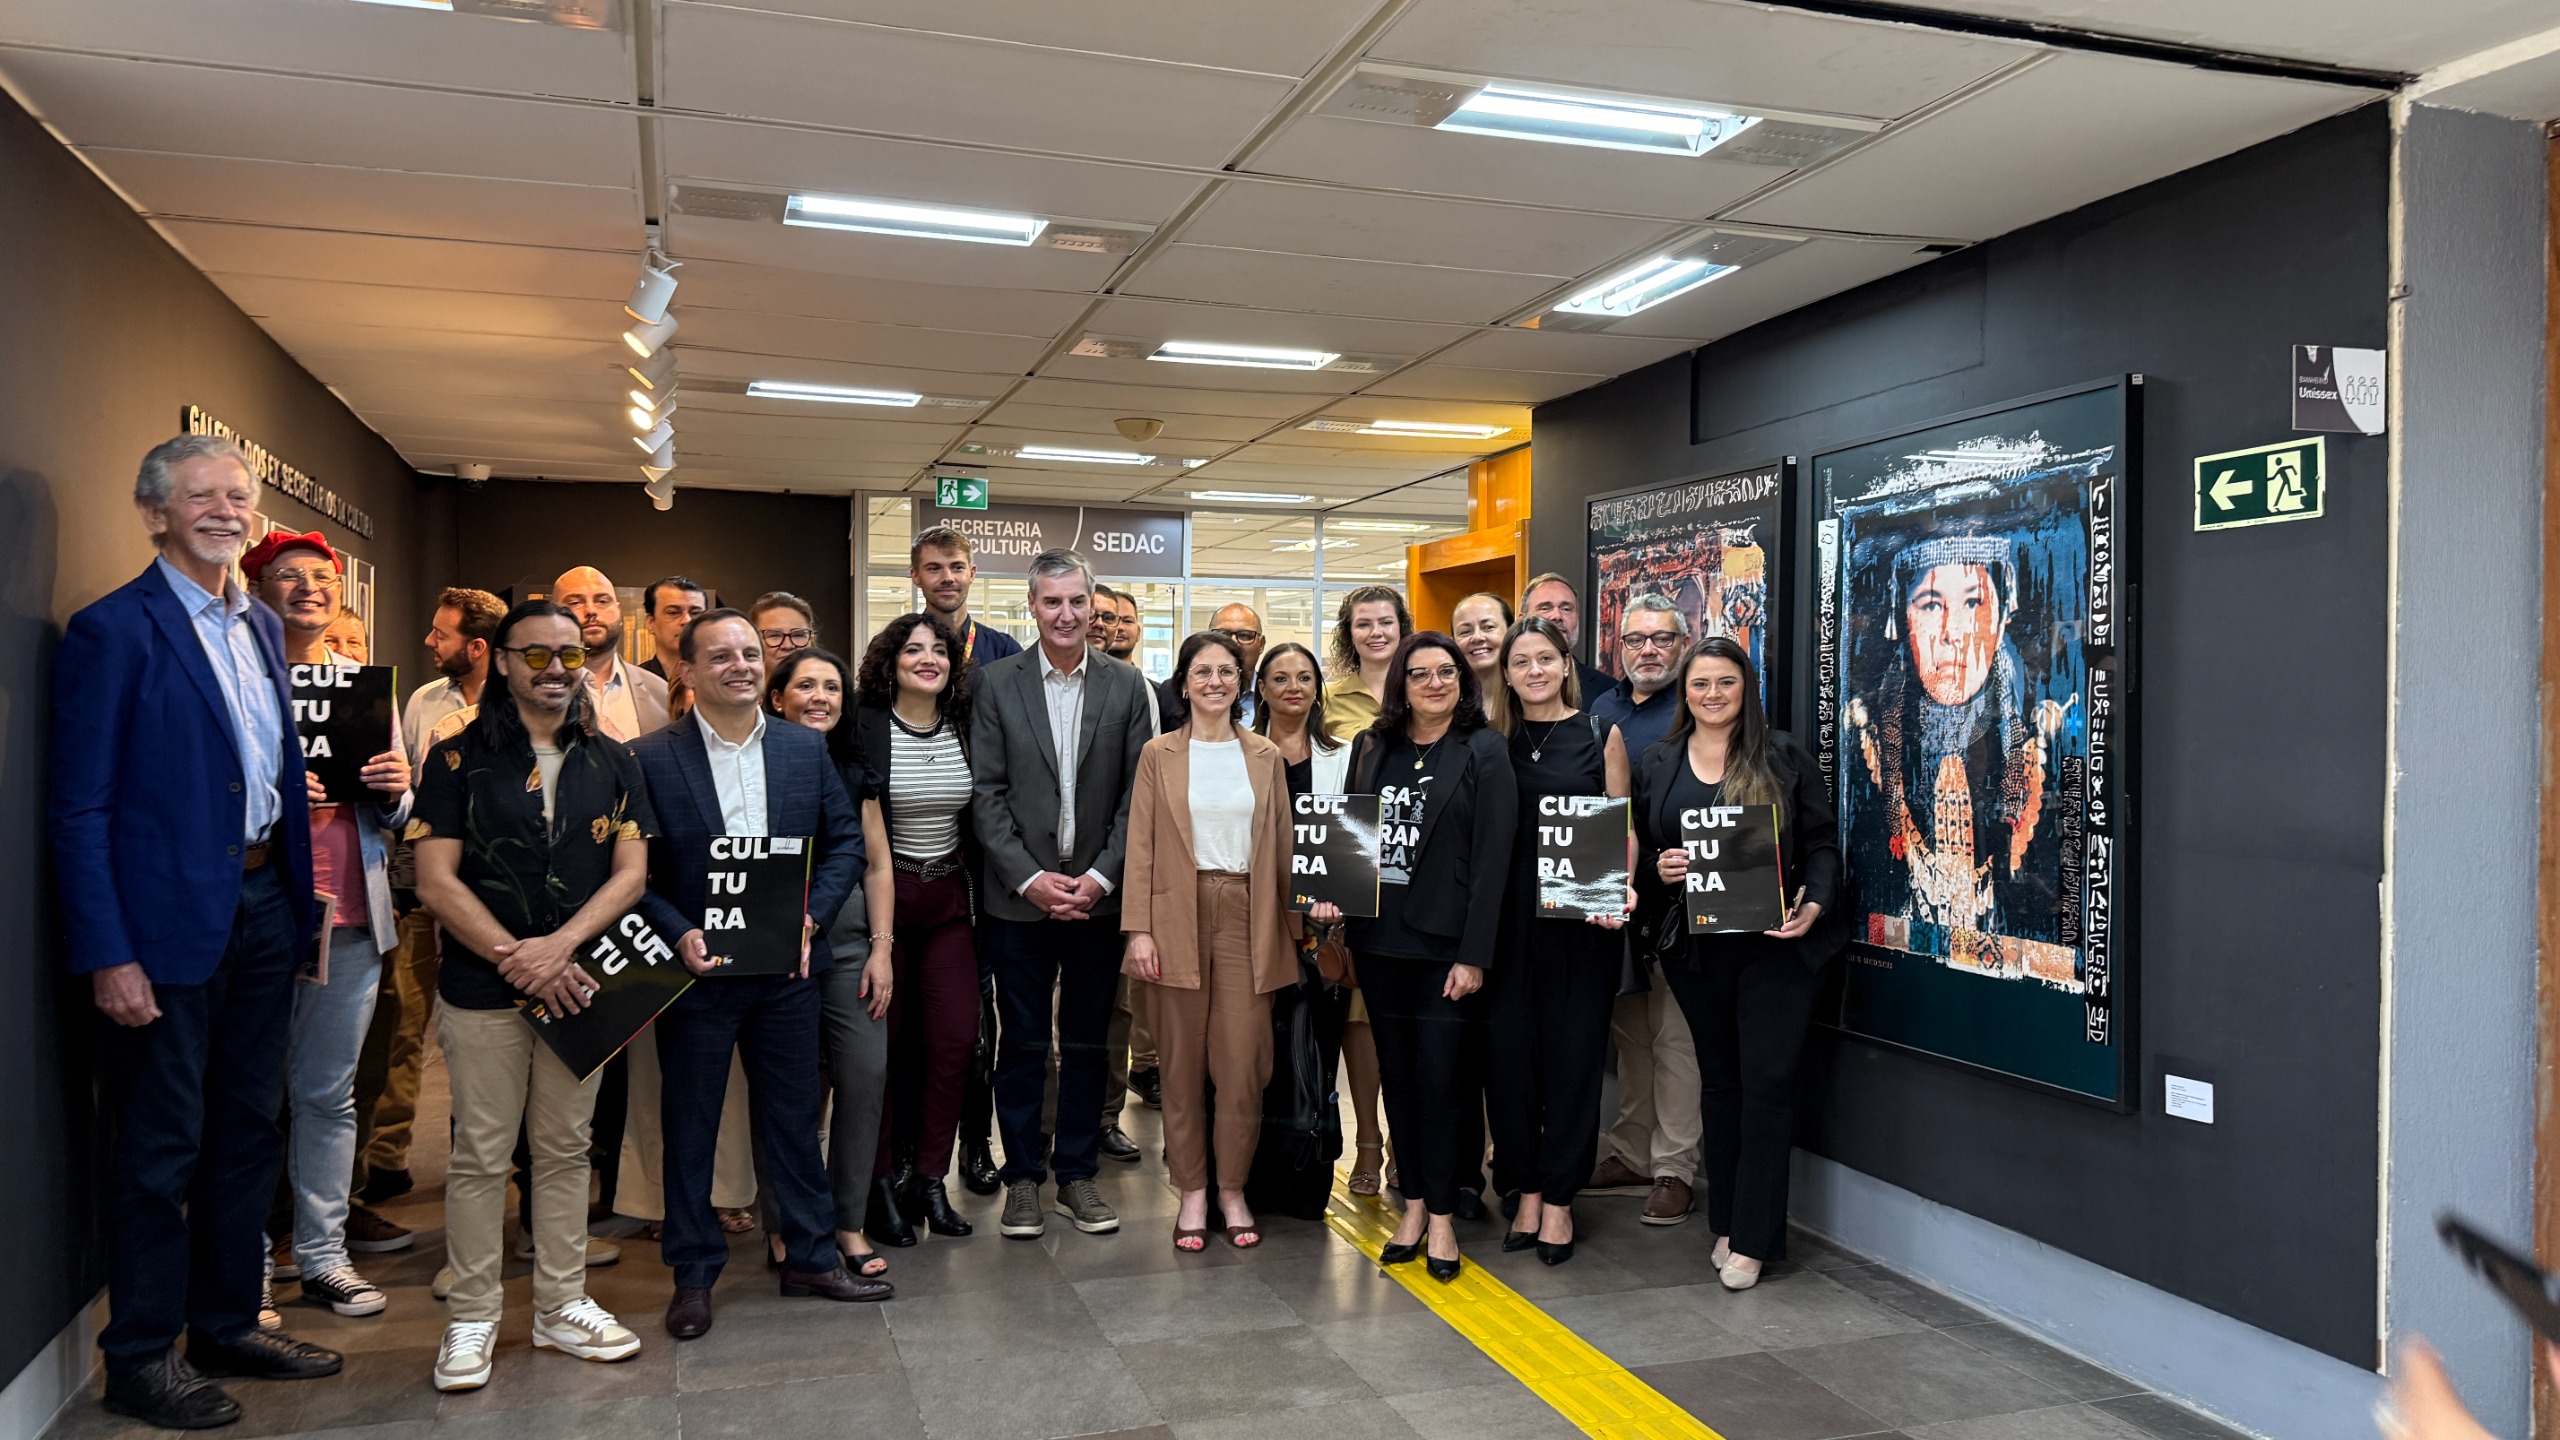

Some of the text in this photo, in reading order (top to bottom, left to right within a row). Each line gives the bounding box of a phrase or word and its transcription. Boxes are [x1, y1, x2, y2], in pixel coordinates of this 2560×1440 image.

[2299, 386, 2338, 400] Unissex
[268, 454, 280, 488] EX
[940, 518, 1043, 538] SECRETARIA
[968, 538, 1043, 556] CULTURA
[1092, 532, 1165, 555] SEDAC
[290, 665, 353, 688] CUL
[291, 700, 331, 722] TU
[1295, 794, 1345, 815] CUL
[1381, 785, 1411, 806] SA
[1539, 796, 1592, 817] CUL
[1382, 804, 1401, 825] PI
[1681, 808, 1736, 830] CUL
[1294, 824, 1327, 844] TU
[1538, 826, 1573, 847] TU
[709, 837, 769, 860] CUL
[1380, 844, 1407, 866] GA
[1683, 839, 1720, 861] TU
[1291, 855, 1328, 875] RA
[1537, 857, 1576, 878] RA
[707, 872, 748, 895] TU
[1685, 871, 1726, 893] RA
[704, 907, 747, 930] RA
[590, 935, 630, 976] TU
